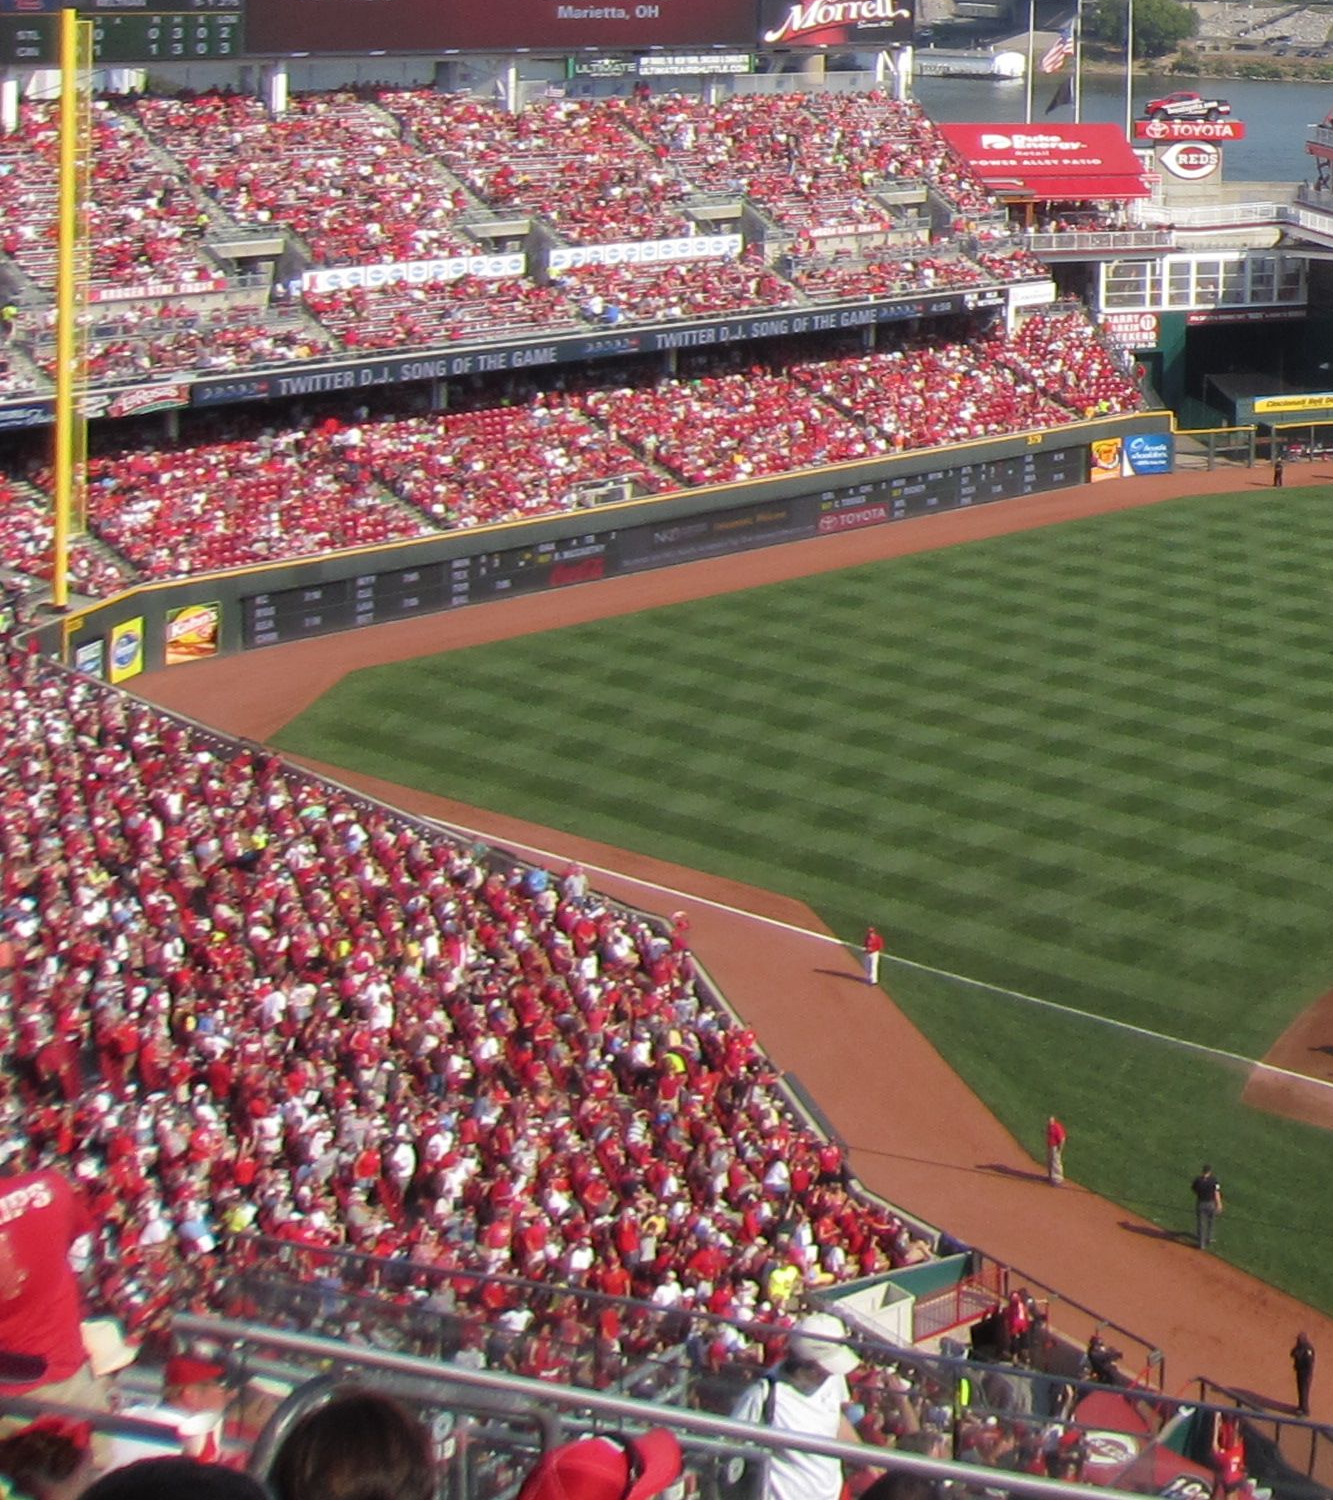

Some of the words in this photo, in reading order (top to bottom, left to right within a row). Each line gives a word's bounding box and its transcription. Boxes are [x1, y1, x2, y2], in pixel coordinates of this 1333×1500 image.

[557, 5, 630, 20] Marietta,
[635, 5, 659, 19] OH
[148, 28, 160, 39] 0
[172, 27, 184, 39] 3
[197, 27, 208, 39] 0
[219, 27, 231, 39] 2
[150, 44, 158, 54] 1
[172, 43, 184, 54] 3
[196, 44, 207, 54] 0
[220, 43, 231, 54] 3
[576, 62, 636, 74] ULTIMATE
[1171, 124, 1234, 136] TOYOTA
[1012, 134, 1062, 143] Duke
[1012, 141, 1081, 150] Energy
[1178, 153, 1218, 166] REDS
[656, 327, 716, 349] TWITTER
[720, 324, 747, 343] D.J.
[751, 318, 789, 339] SONG
[794, 316, 810, 333] OF
[812, 313, 836, 329] THE
[841, 308, 877, 327] GAME
[278, 370, 355, 397] TWITTER
[360, 367, 394, 387] D.J.
[400, 359, 447, 381] SONG
[452, 357, 473, 375] OF
[477, 353, 507, 371] THE
[512, 347, 558, 368] GAME
[839, 508, 887, 526] TOYOTA
